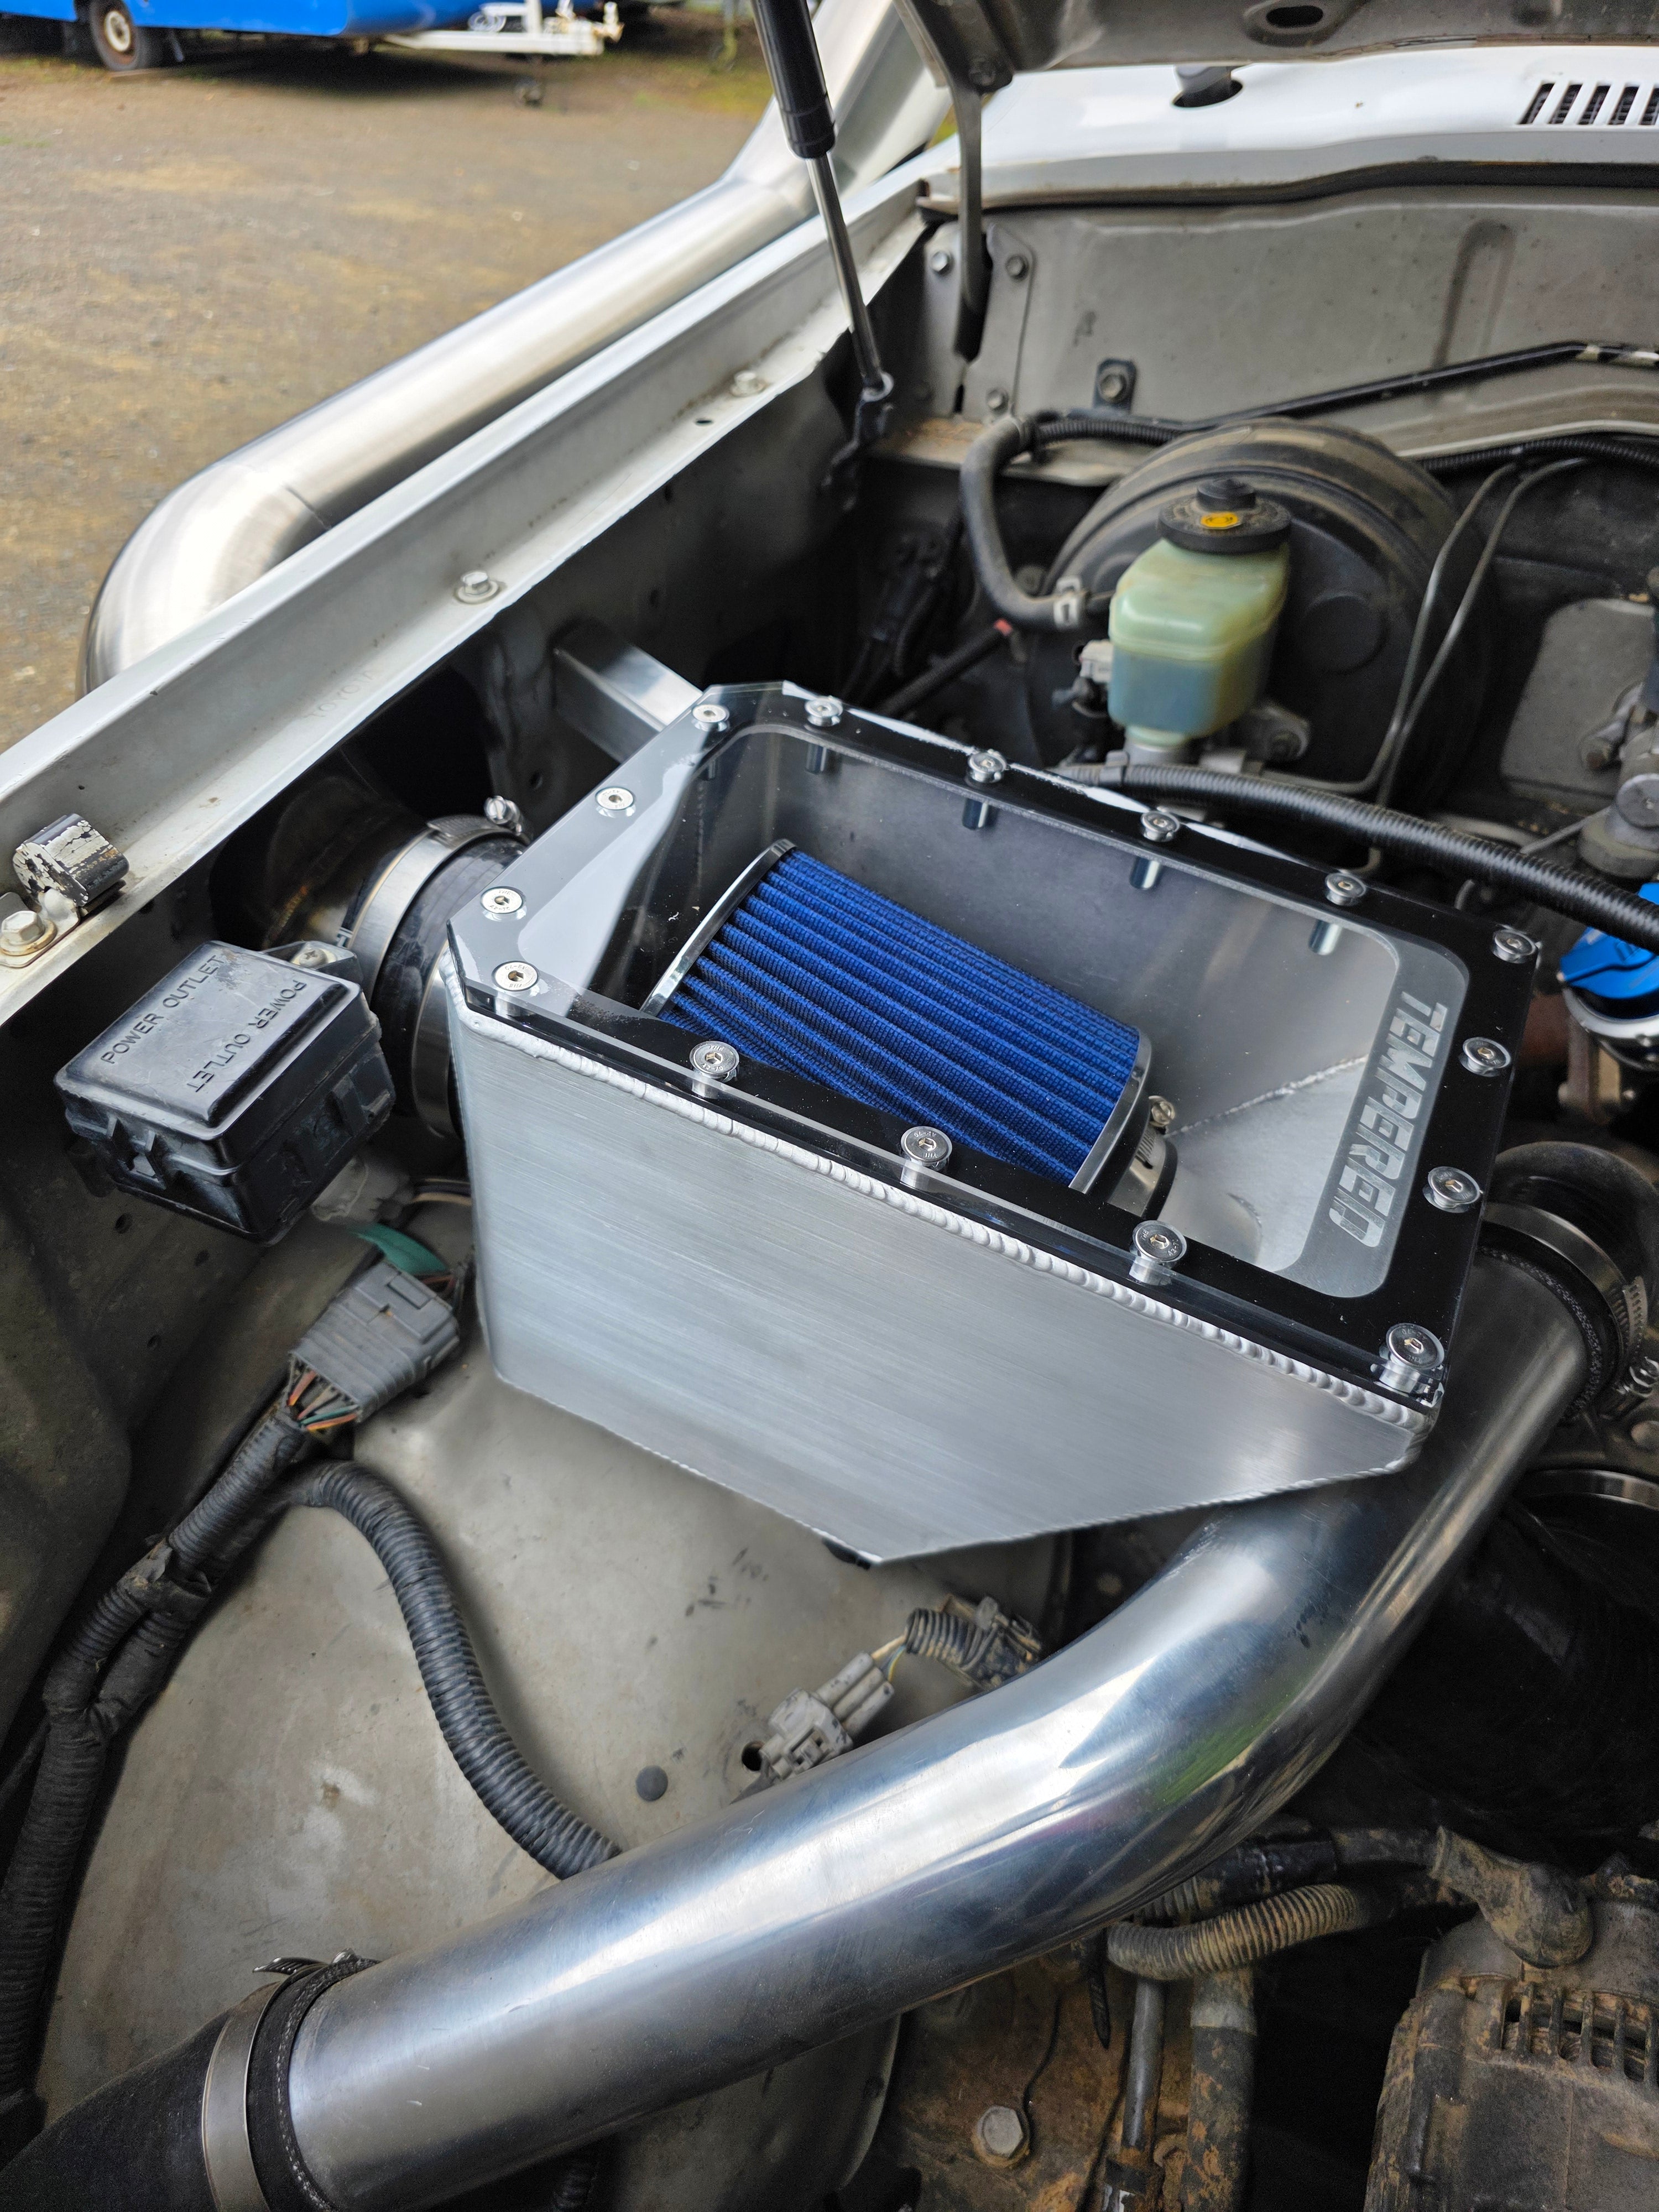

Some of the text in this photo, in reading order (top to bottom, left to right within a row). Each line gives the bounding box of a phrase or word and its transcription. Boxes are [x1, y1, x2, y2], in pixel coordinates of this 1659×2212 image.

[101, 954, 226, 1064] POWER OUTLET
[187, 979, 307, 1093] POWER OUTLET
[1329, 991, 1448, 1248] TEMPERED
